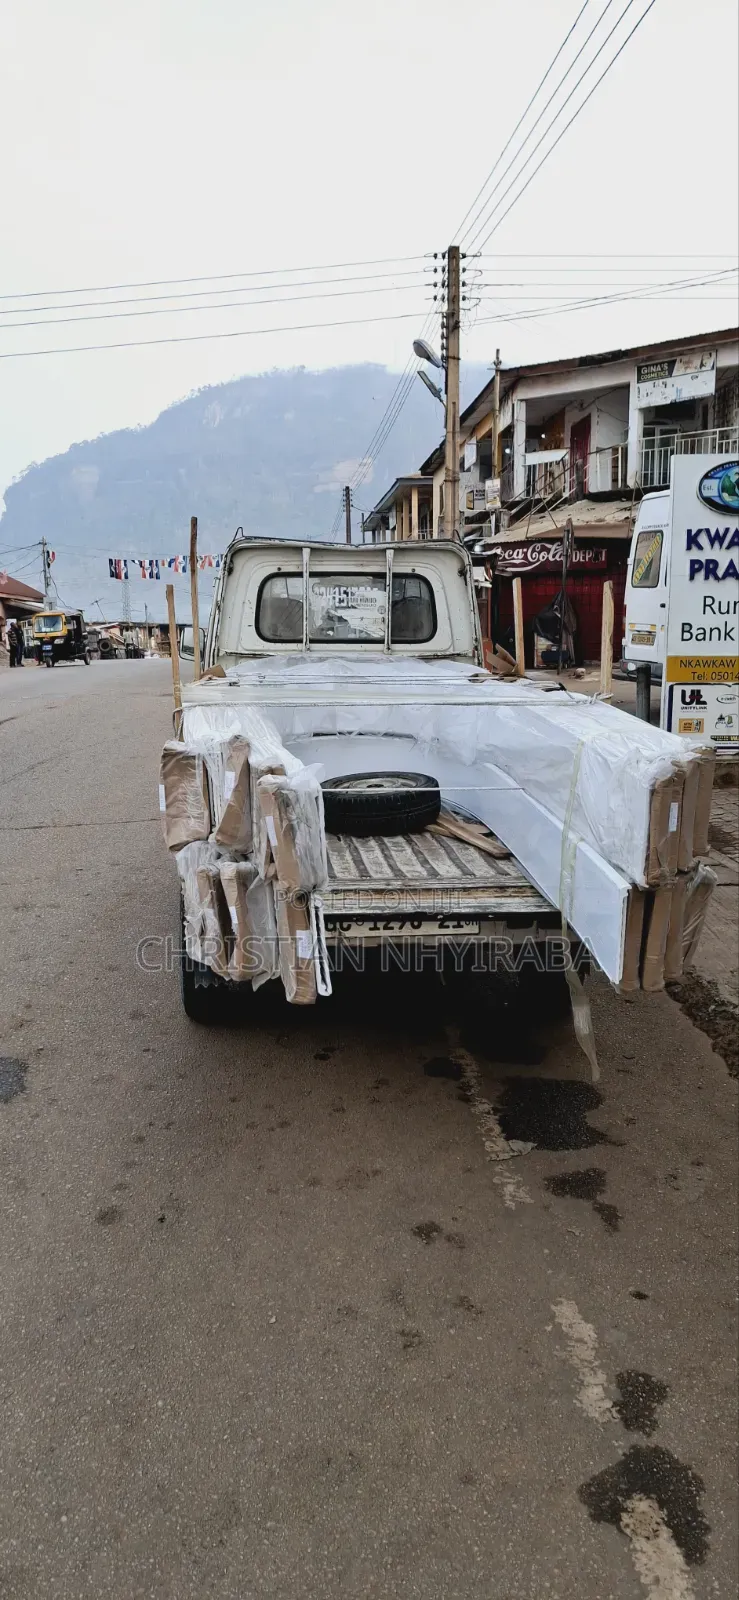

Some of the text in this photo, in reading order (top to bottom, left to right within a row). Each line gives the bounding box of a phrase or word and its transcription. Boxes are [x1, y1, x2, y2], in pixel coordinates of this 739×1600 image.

[641, 362, 669, 375] GINA'S
[689, 558, 739, 582] PRA
[681, 621, 736, 642] Bank
[679, 659, 737, 669] NKAWKAW
[691, 671, 708, 681] Tel:
